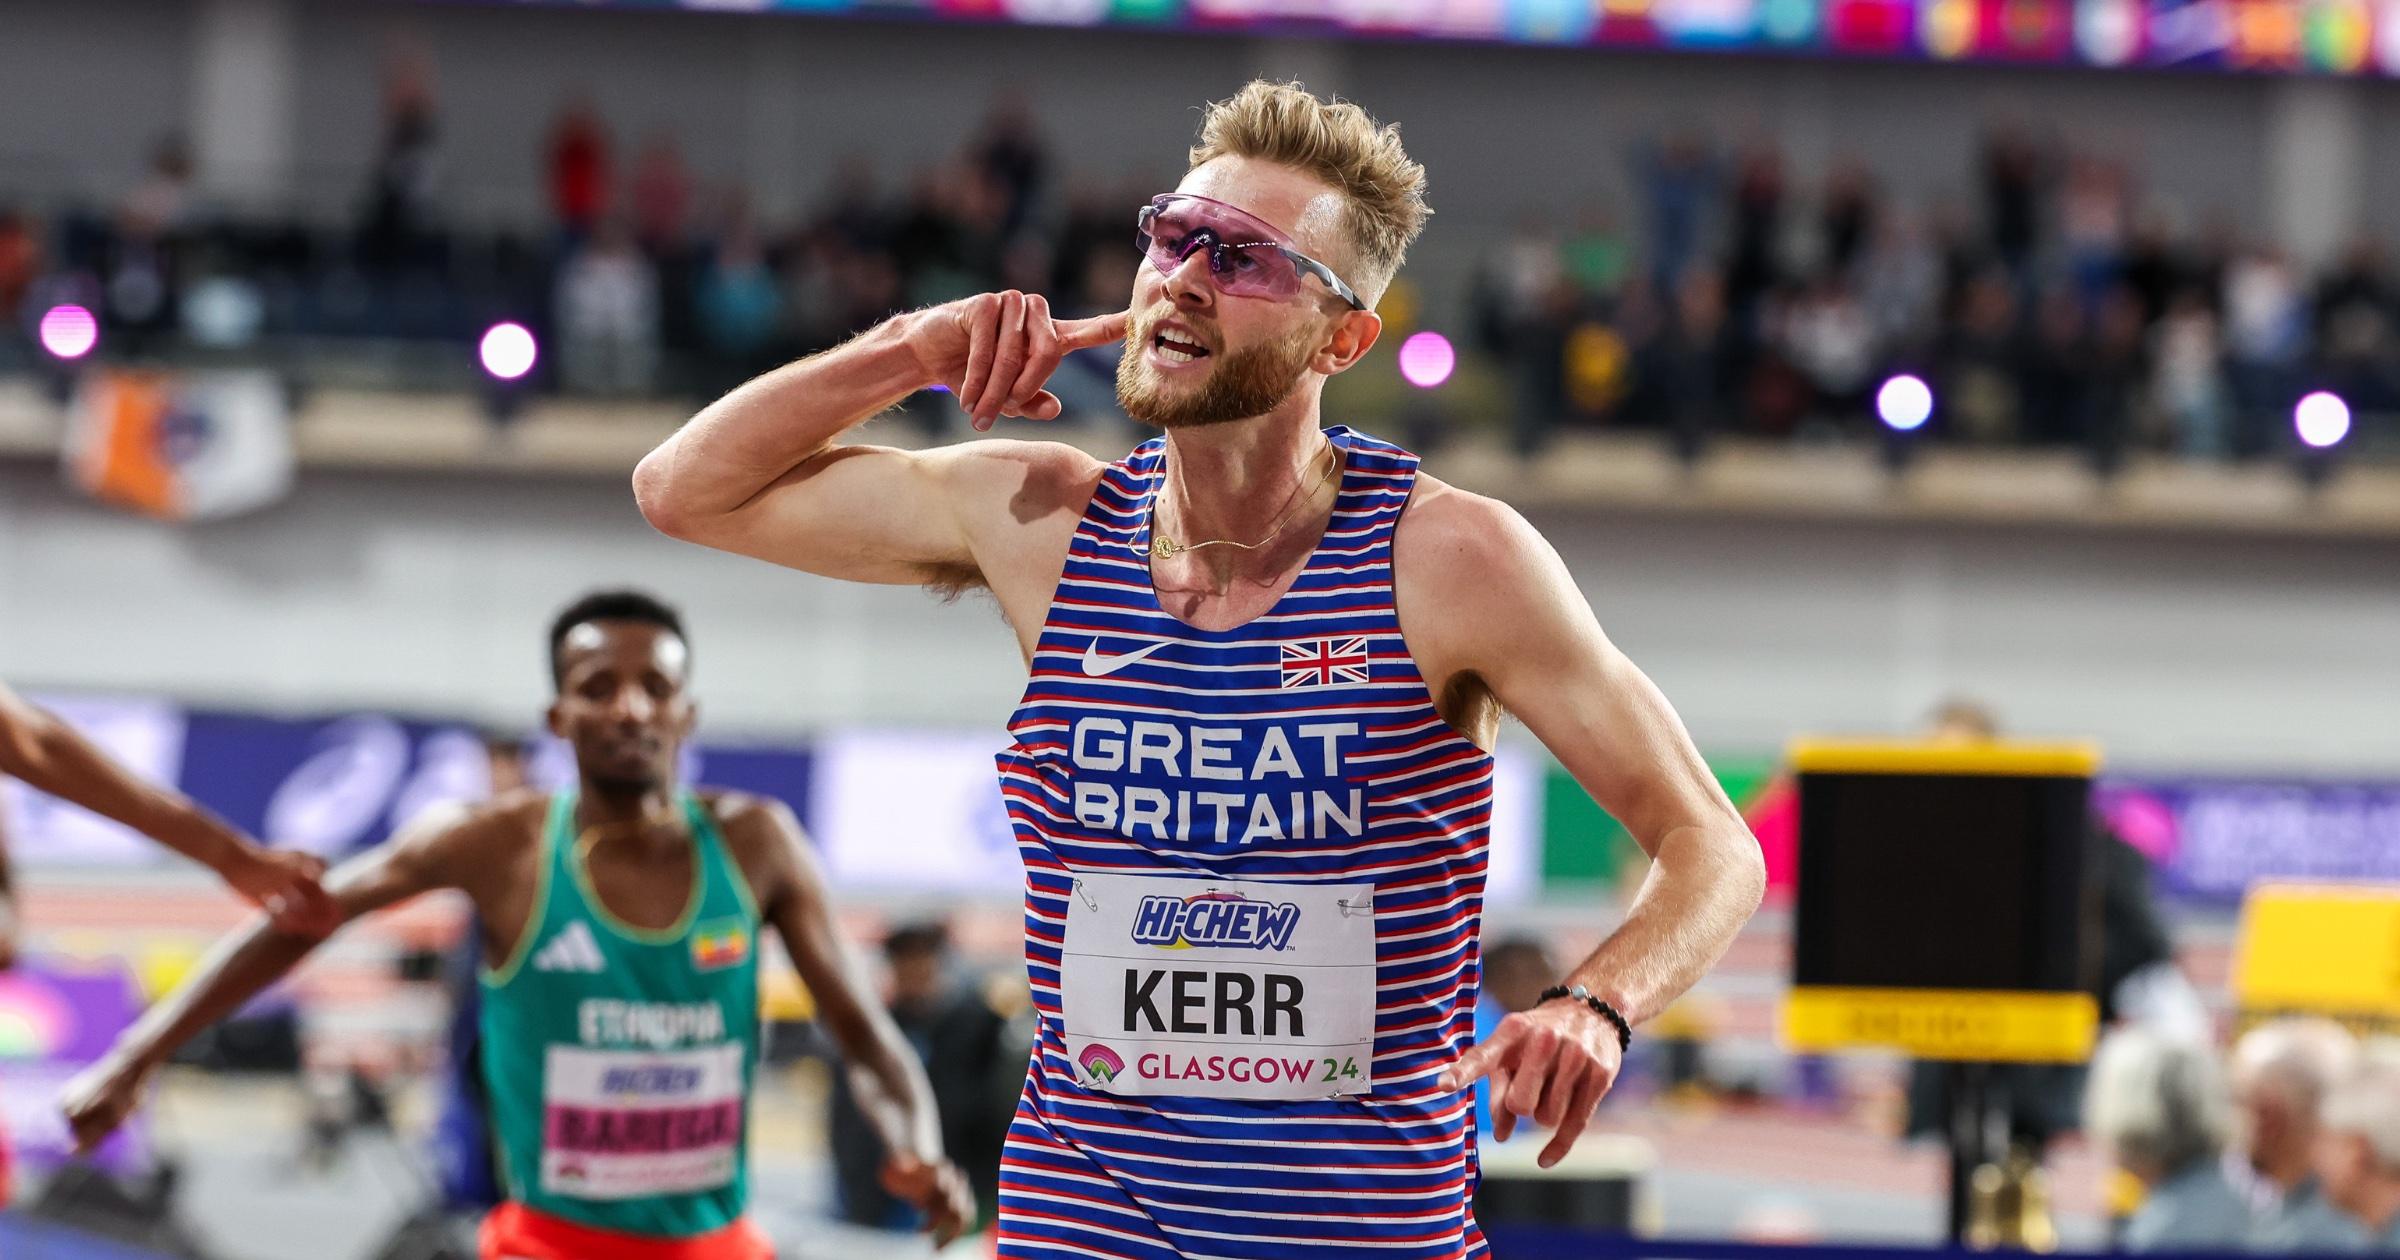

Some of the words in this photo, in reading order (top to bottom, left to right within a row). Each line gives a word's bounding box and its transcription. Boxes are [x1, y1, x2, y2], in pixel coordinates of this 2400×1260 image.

[1073, 717, 1359, 780] GREAT
[1074, 781, 1362, 844] BRITAIN
[1132, 895, 1300, 951] HI-CHEW
[1123, 968, 1305, 1038] KERR
[1137, 1053, 1315, 1084] GLASGOW
[1321, 1056, 1359, 1082] 24
